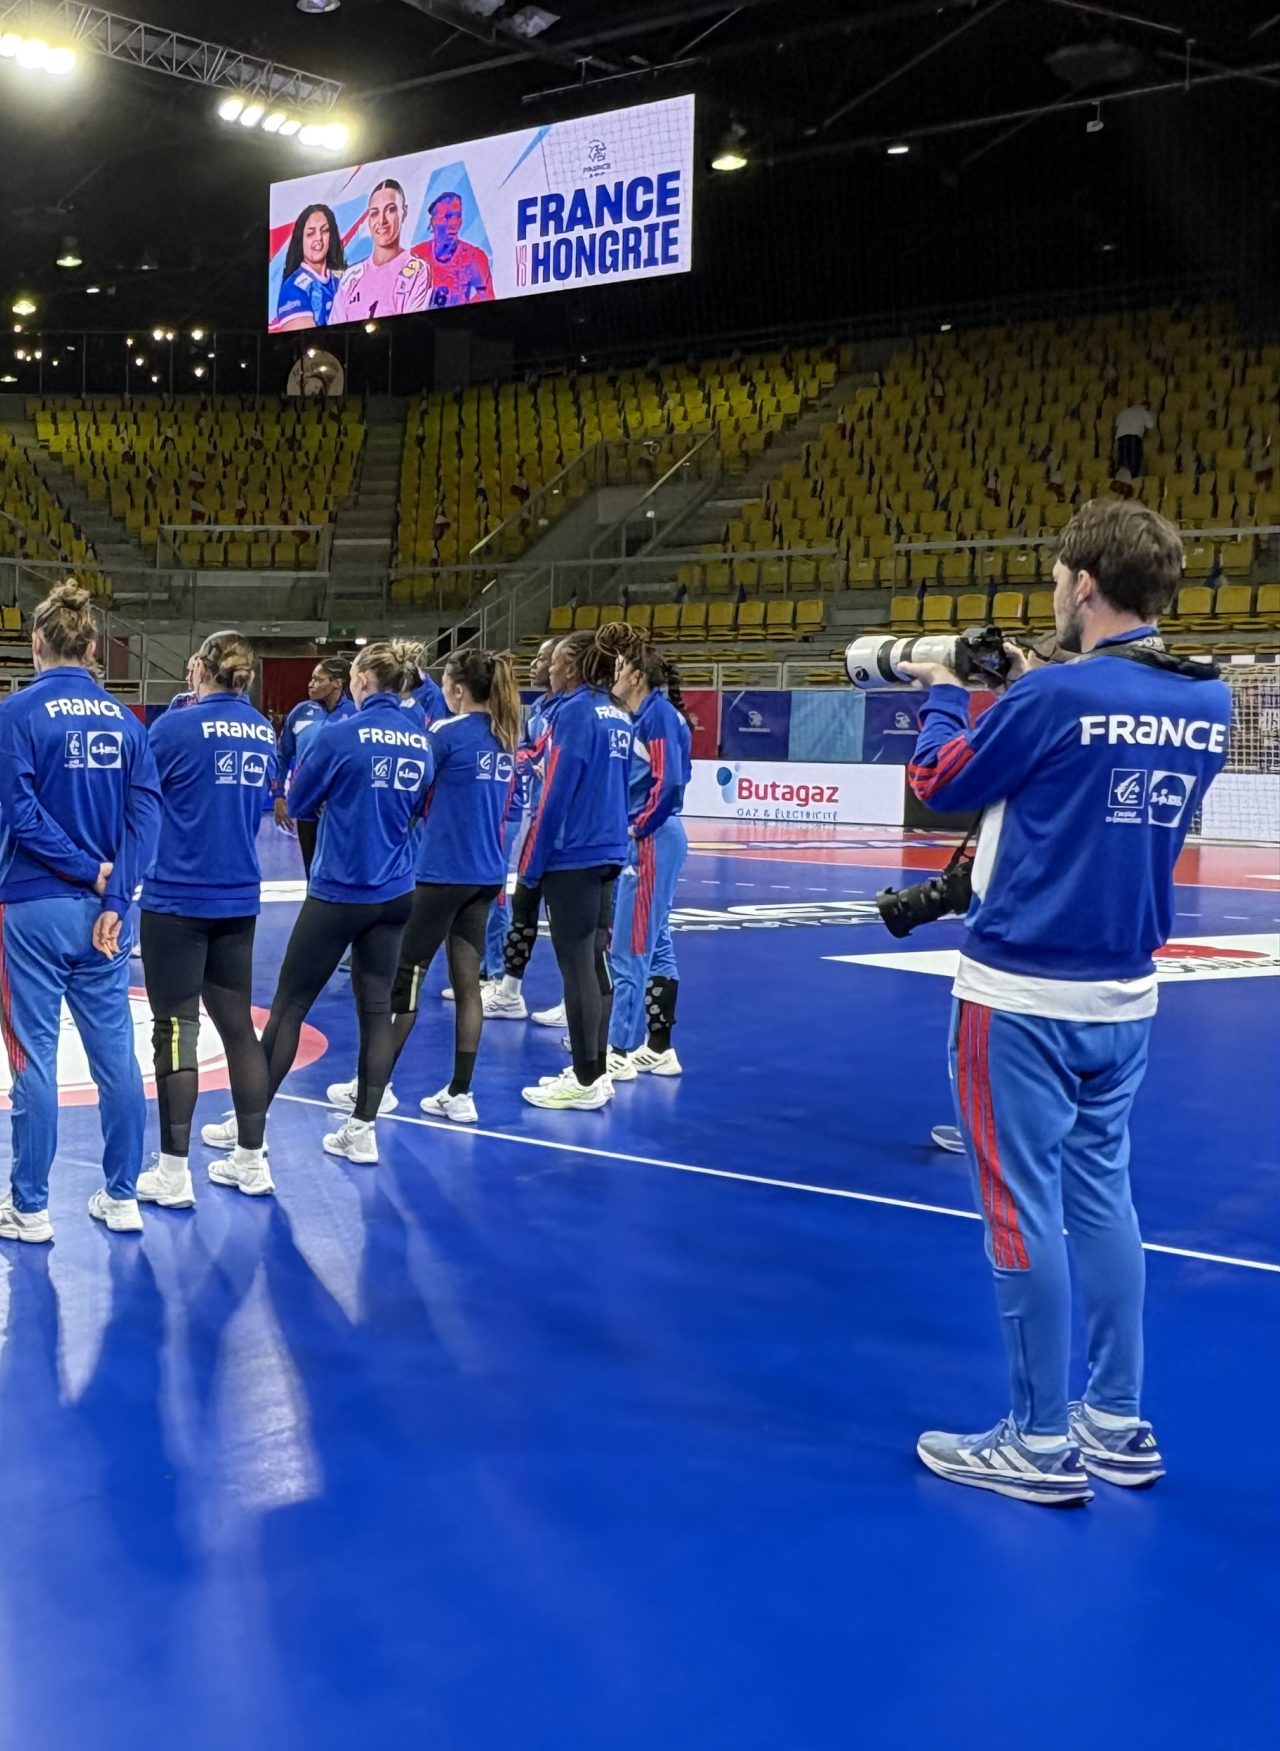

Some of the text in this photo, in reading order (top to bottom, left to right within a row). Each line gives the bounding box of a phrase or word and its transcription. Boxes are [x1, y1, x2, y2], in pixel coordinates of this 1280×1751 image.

[517, 170, 681, 241] FRANCE
[531, 219, 680, 285] HONGRIE
[738, 778, 839, 807] Butagaz
